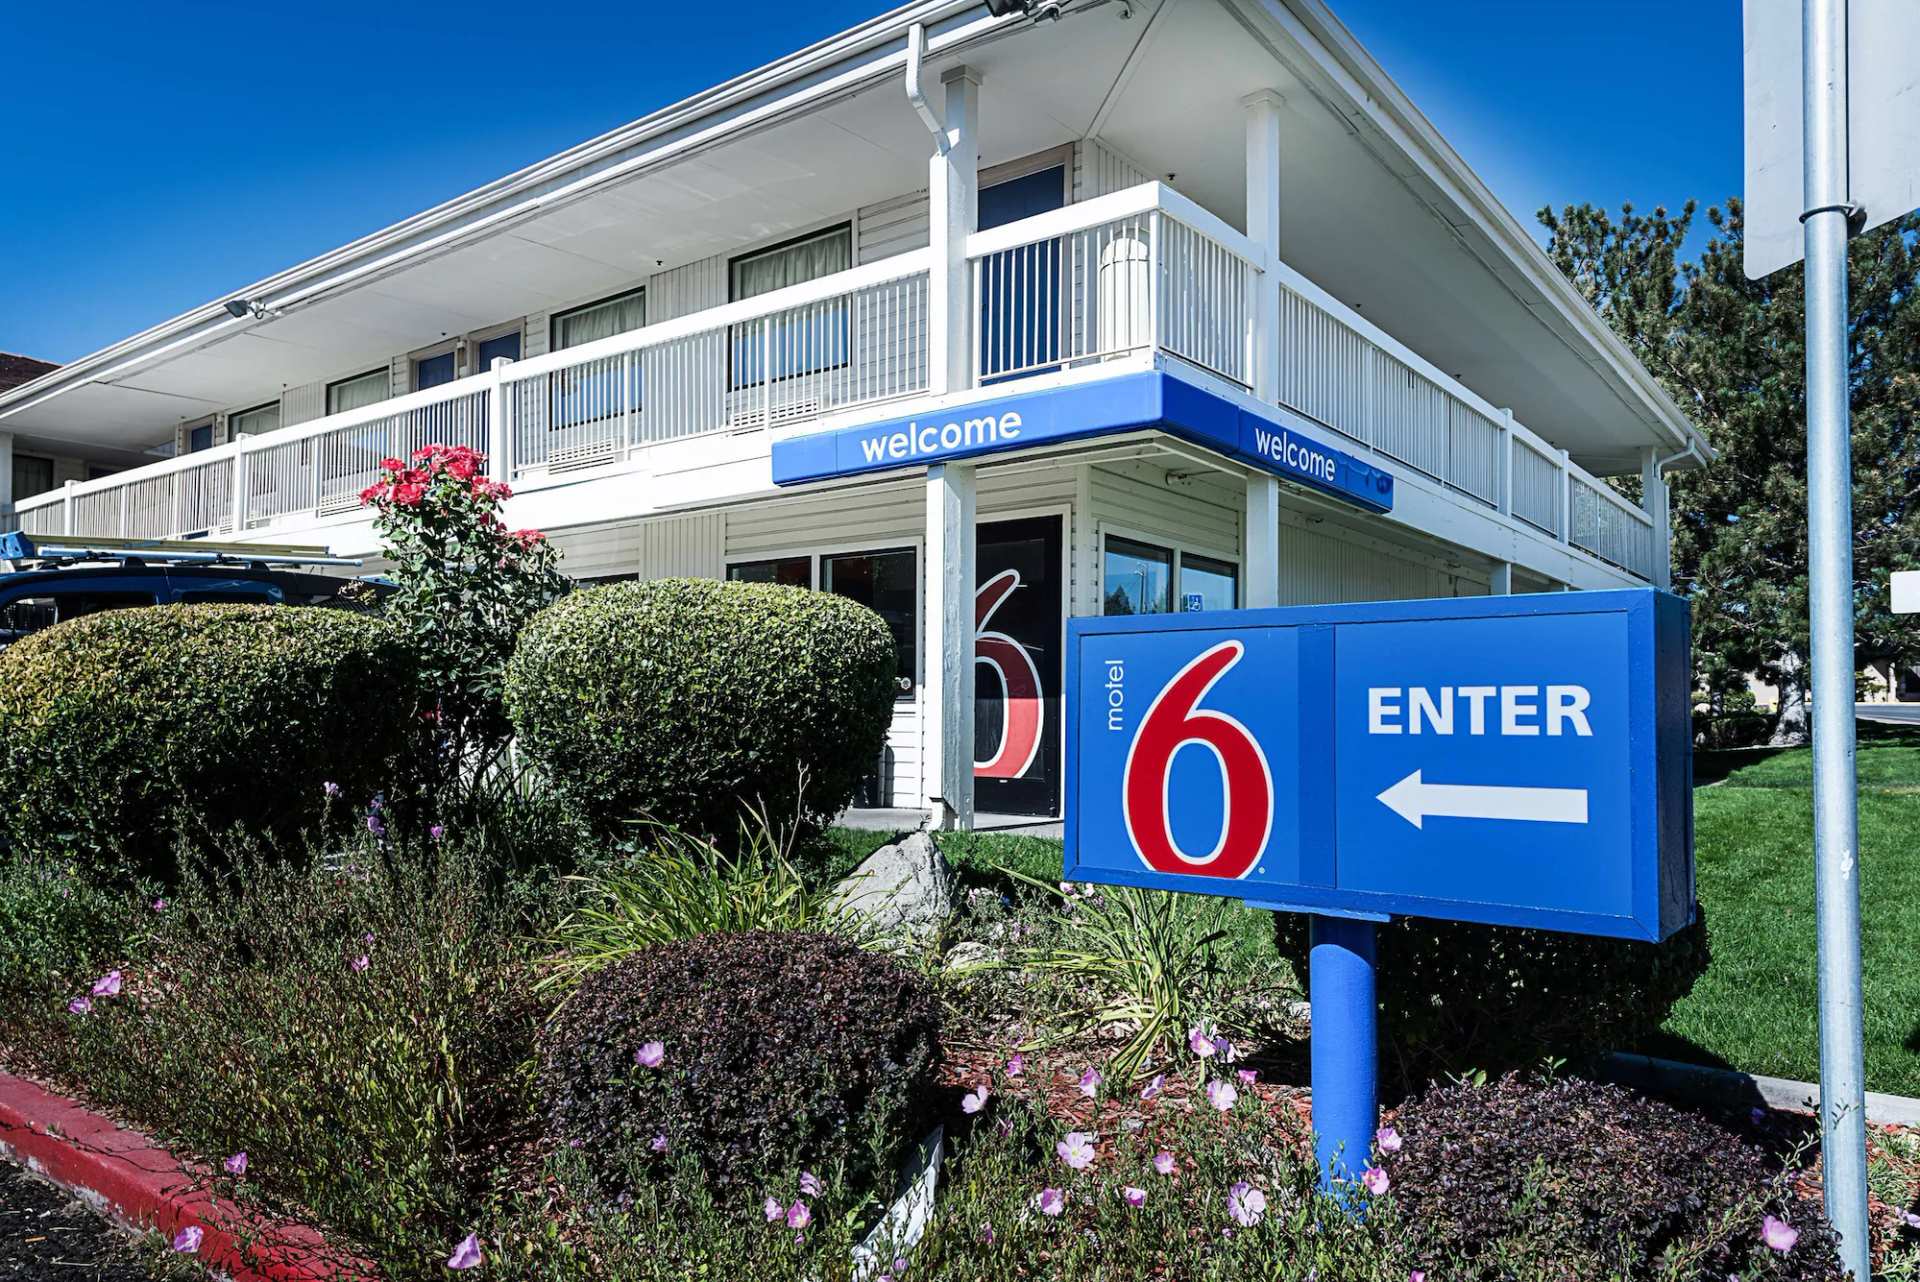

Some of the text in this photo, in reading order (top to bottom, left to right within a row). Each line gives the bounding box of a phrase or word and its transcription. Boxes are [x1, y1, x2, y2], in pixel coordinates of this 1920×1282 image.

[859, 411, 1023, 464] welcome
[1254, 427, 1336, 482] welcome
[1104, 659, 1127, 732] motel
[1367, 685, 1594, 737] ENTER
[1122, 639, 1275, 881] 6
